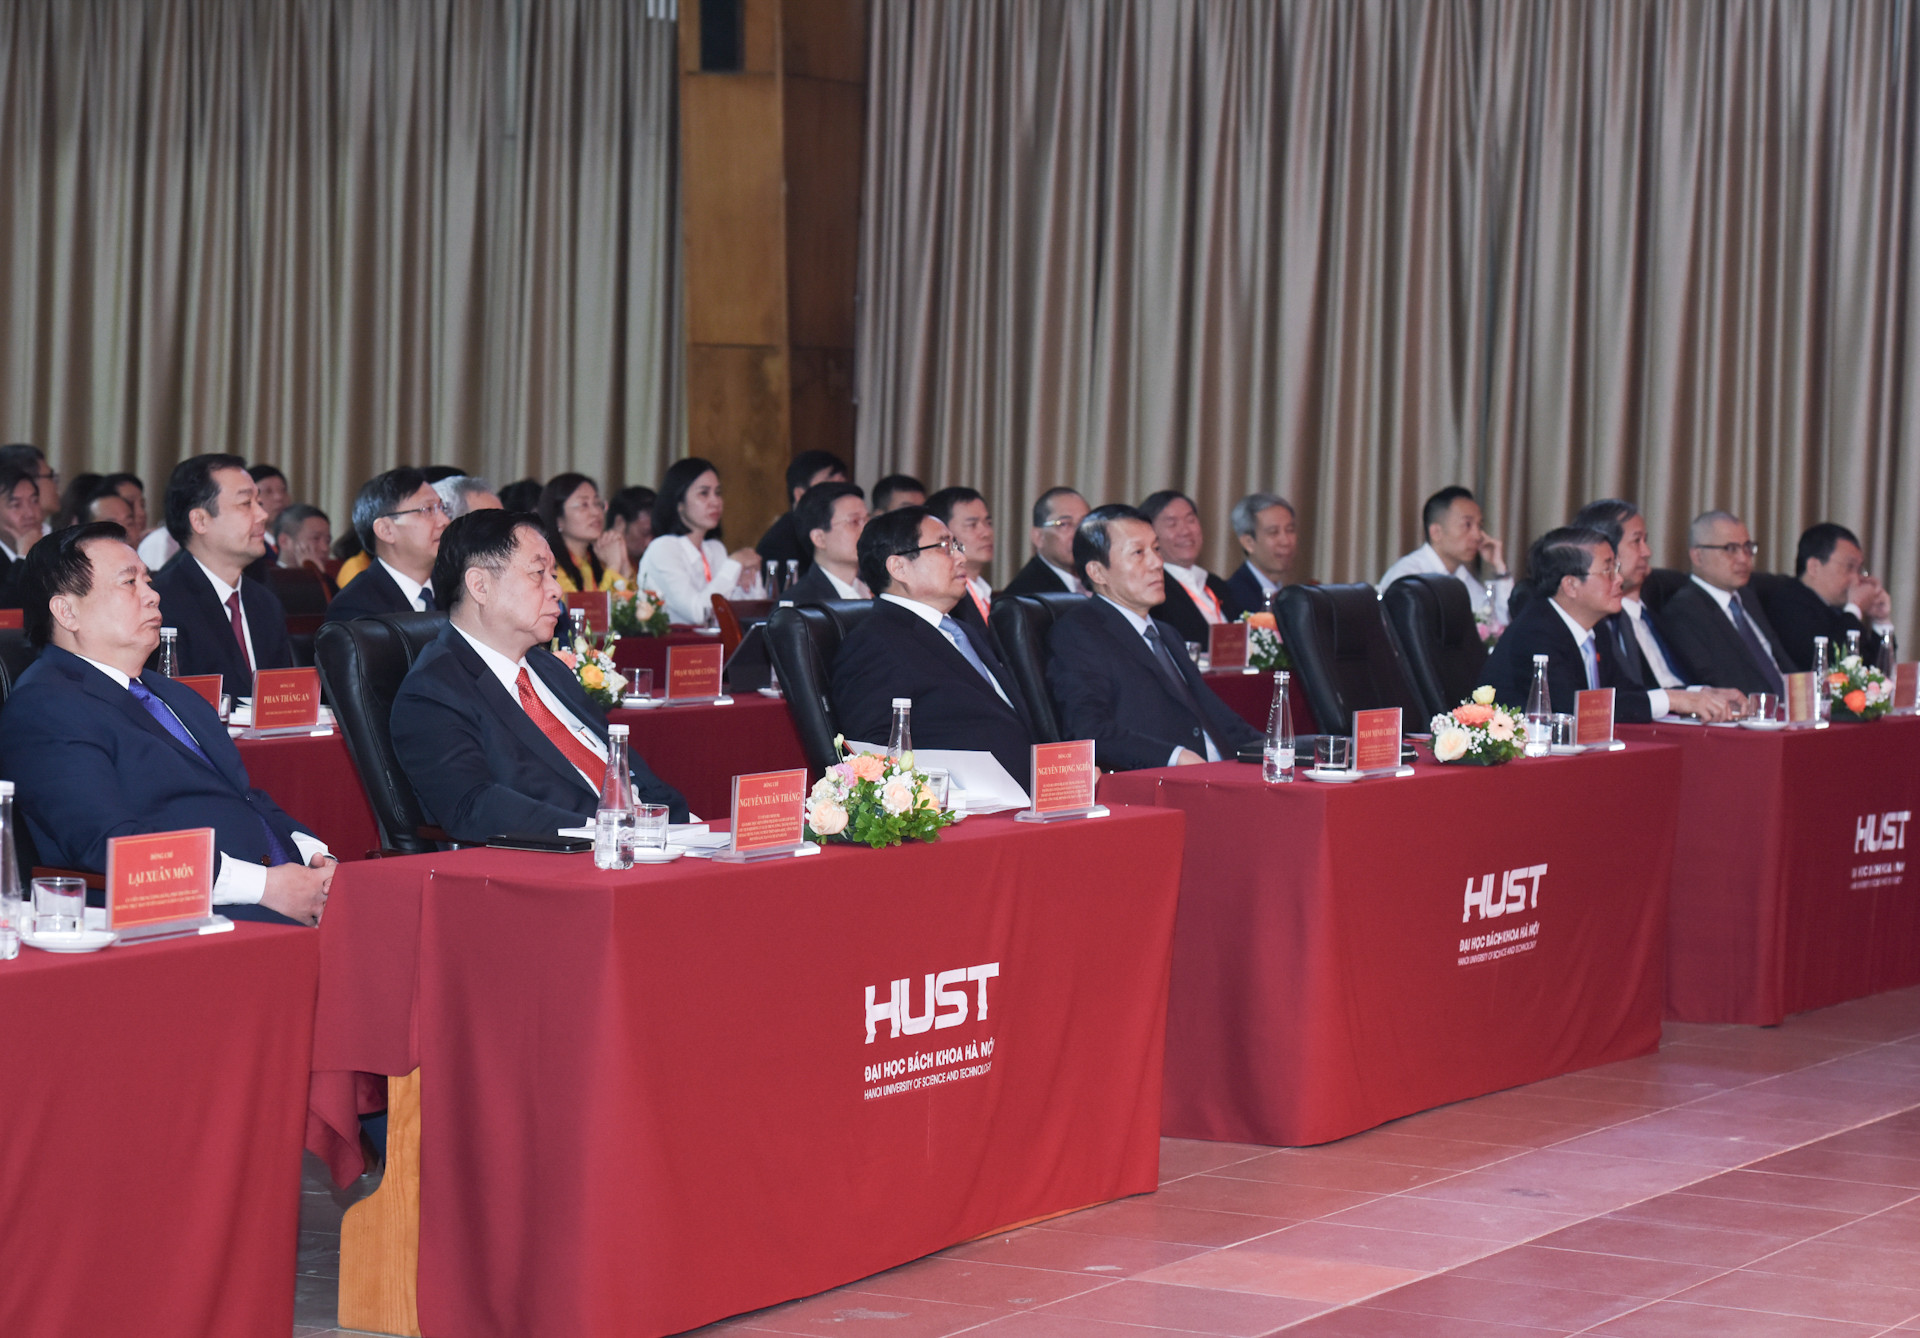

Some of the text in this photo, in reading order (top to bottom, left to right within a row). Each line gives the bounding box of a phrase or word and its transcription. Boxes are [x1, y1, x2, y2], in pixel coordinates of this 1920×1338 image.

[264, 695, 280, 704] PHAN
[300, 692, 310, 701] AN
[739, 795, 763, 808] NGUYỄN
[763, 792, 780, 805] XUÂN
[1854, 809, 1912, 854] HUST
[128, 862, 195, 888] LẠI XUÂN MÔN
[1462, 863, 1548, 923] HUST
[1471, 935, 1486, 952] HỌC
[864, 962, 1000, 1045] HUST
[864, 1063, 882, 1083] ĐẠI
[883, 1058, 906, 1080] HỌC
[907, 1050, 934, 1073] BÁCH
[935, 1046, 964, 1067] KHOA
[964, 1039, 980, 1060] HÀ
[864, 1086, 883, 1100] HANOI
[883, 1079, 914, 1096] UNIVERSITY
[913, 1078, 922, 1090] OF
[922, 1072, 946, 1088] SCIENCE
[946, 1069, 960, 1082] AND
